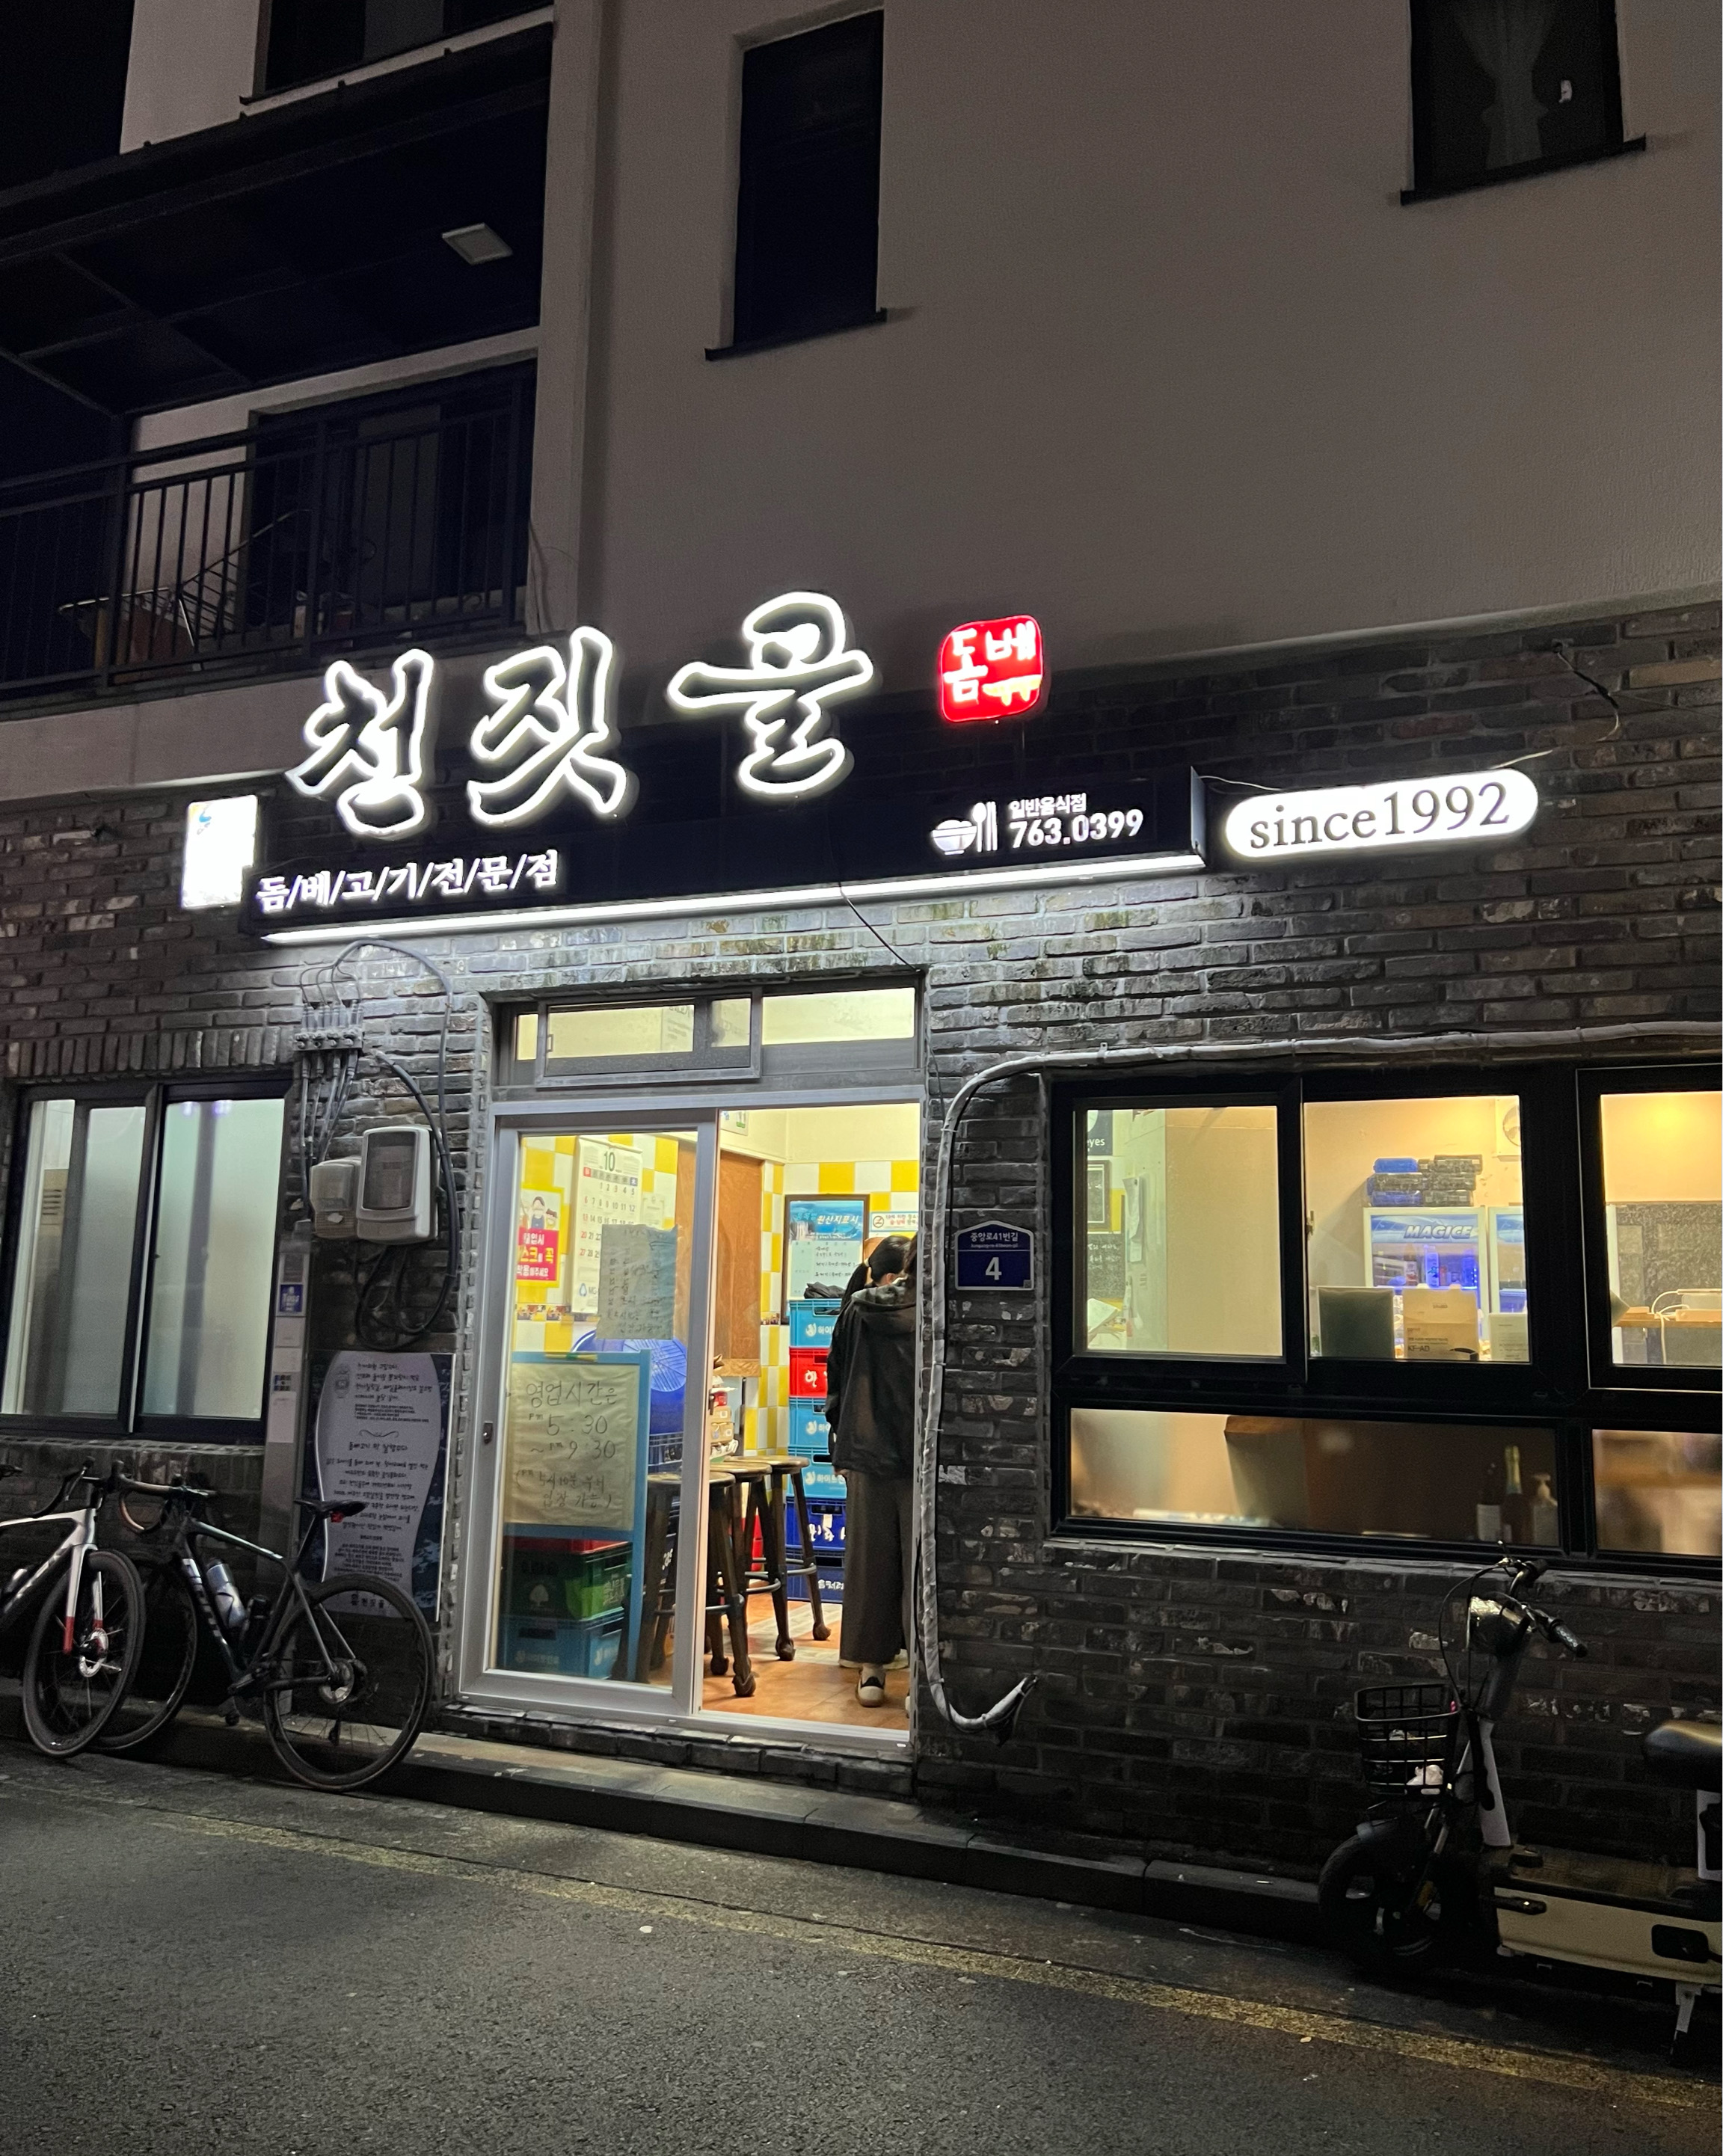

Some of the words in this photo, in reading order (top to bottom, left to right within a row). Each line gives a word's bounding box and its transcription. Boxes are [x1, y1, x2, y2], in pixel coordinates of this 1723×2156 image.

[1010, 792, 1087, 819] 일반음식점
[1250, 781, 1510, 850] since1992
[1010, 808, 1144, 849] 763.0399
[257, 848, 559, 914] 돔/베/고/기/전/문/점
[603, 1151, 615, 1172] 10
[583, 1213, 589, 1221] 13
[590, 1214, 595, 1223] 14
[598, 1216, 603, 1224] 15
[970, 1232, 1019, 1242] 중앙로41번길
[1404, 1225, 1473, 1240] MAGICE
[580, 1248, 586, 1256] 27
[985, 1256, 1002, 1280] 4
[526, 1380, 617, 1408] 영업시간은
